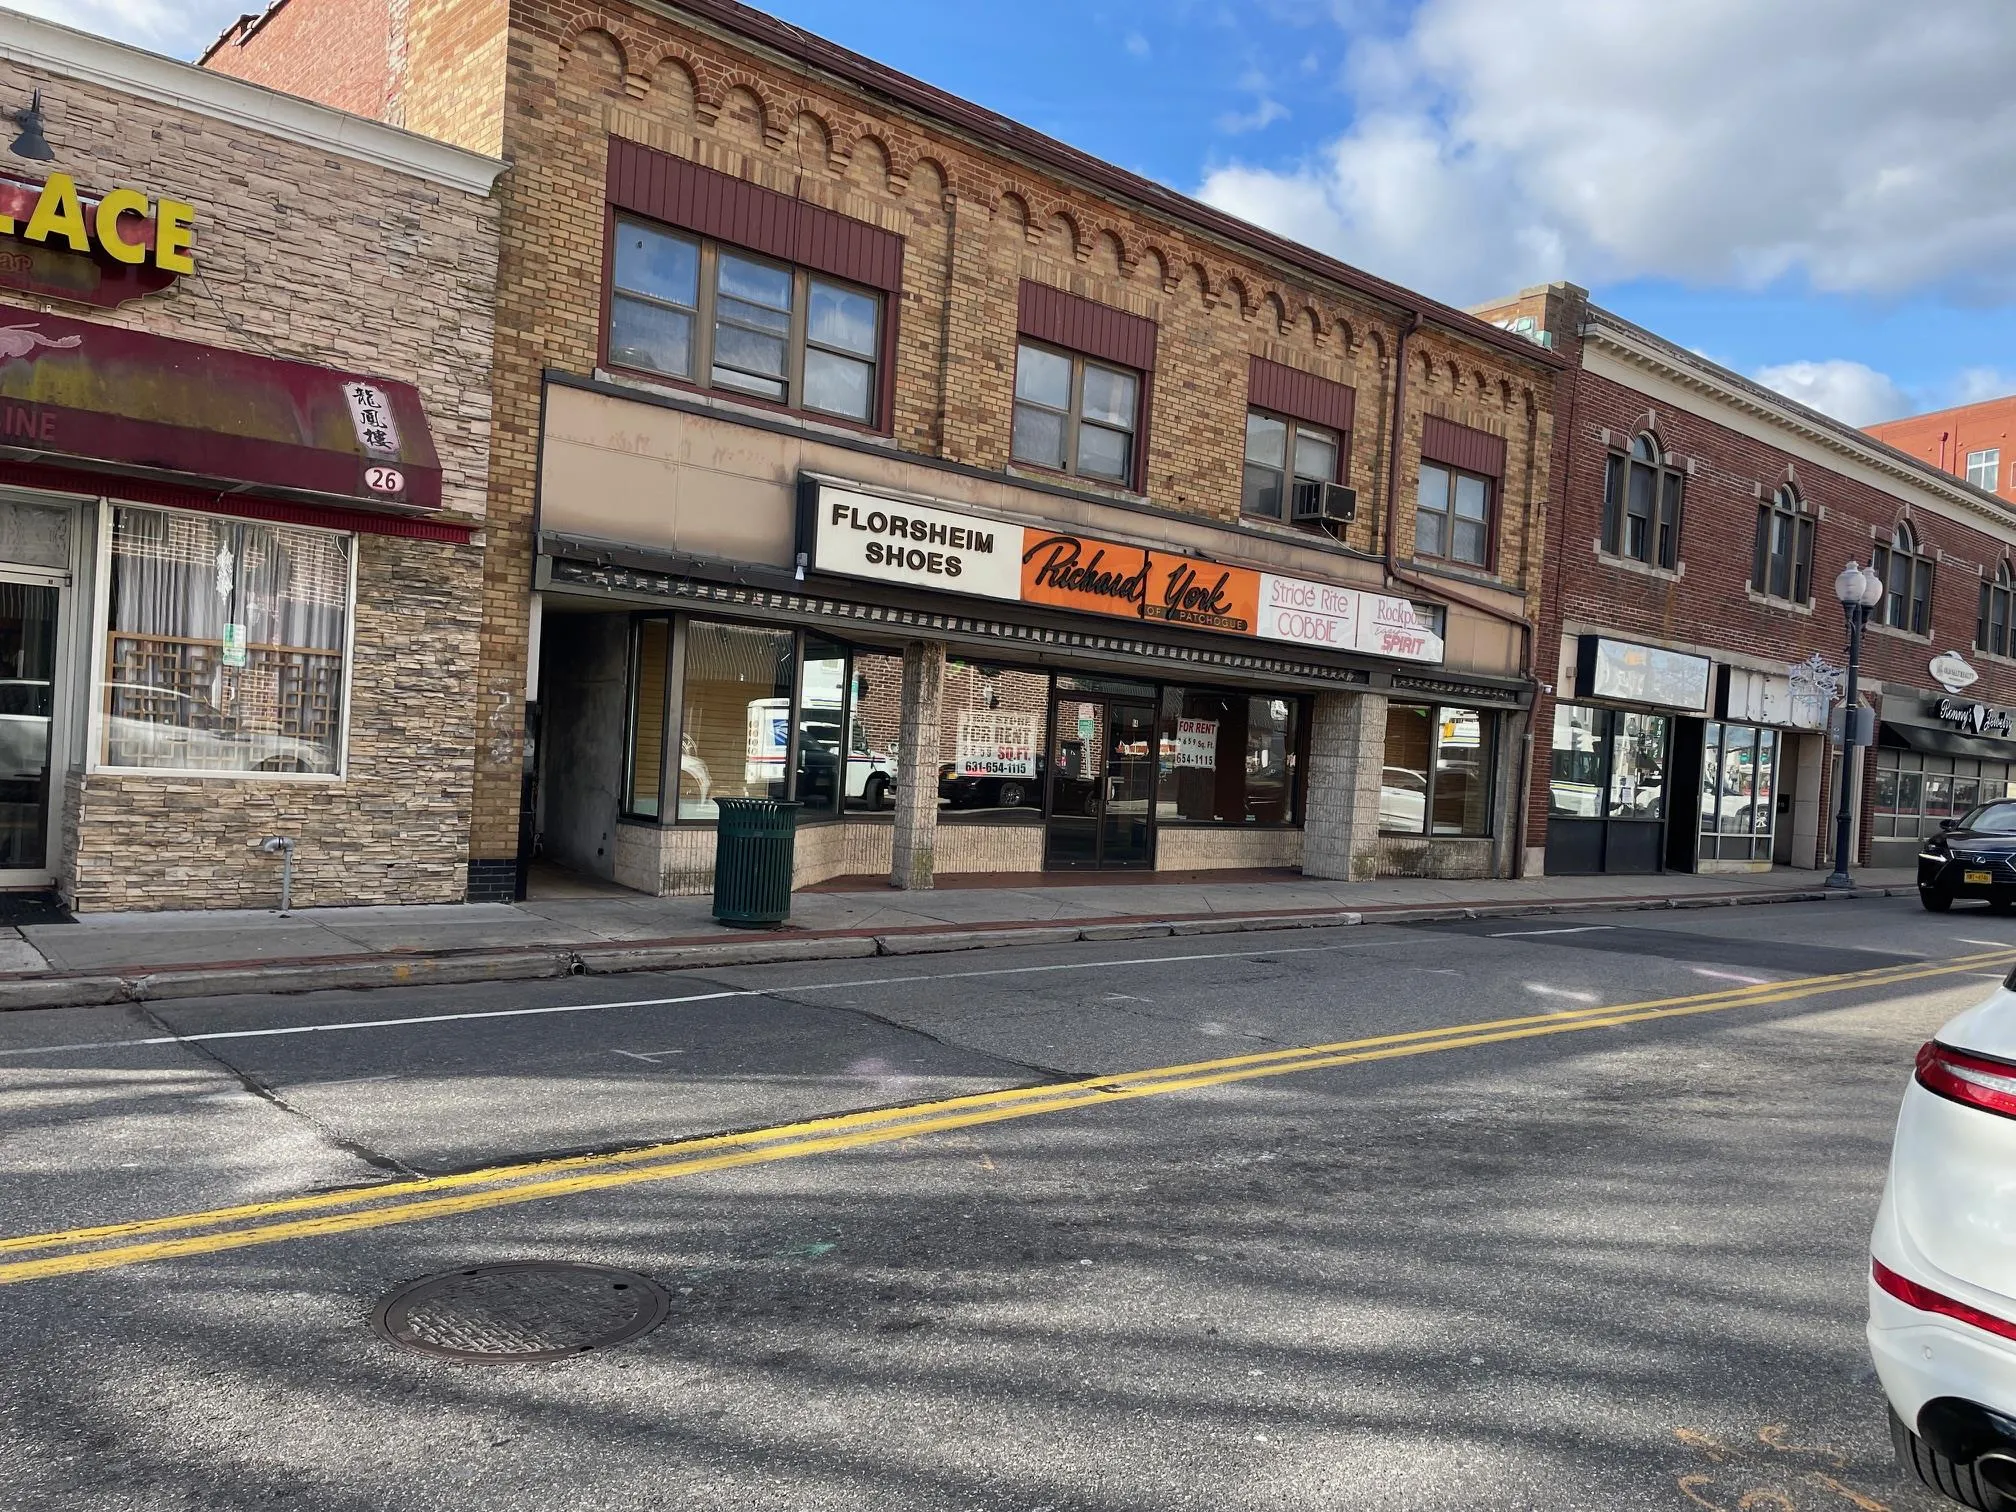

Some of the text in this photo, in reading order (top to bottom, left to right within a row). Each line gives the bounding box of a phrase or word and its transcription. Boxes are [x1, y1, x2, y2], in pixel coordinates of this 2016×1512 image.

[372, 469, 396, 490] 26
[832, 504, 994, 553] FLORSHEIM
[865, 541, 962, 577] SHOES
[1022, 536, 1232, 621] Richard York
[1272, 580, 1348, 613] Stride Rite
[1147, 606, 1243, 630] OF PATCHOGUE
[1382, 634, 1425, 655] SPIRIT
[963, 725, 1031, 745] FOR RENT
[1179, 720, 1216, 735] FOR RENT
[965, 761, 1027, 774] 631-654-1115
[1176, 753, 1213, 766] 654-1115
